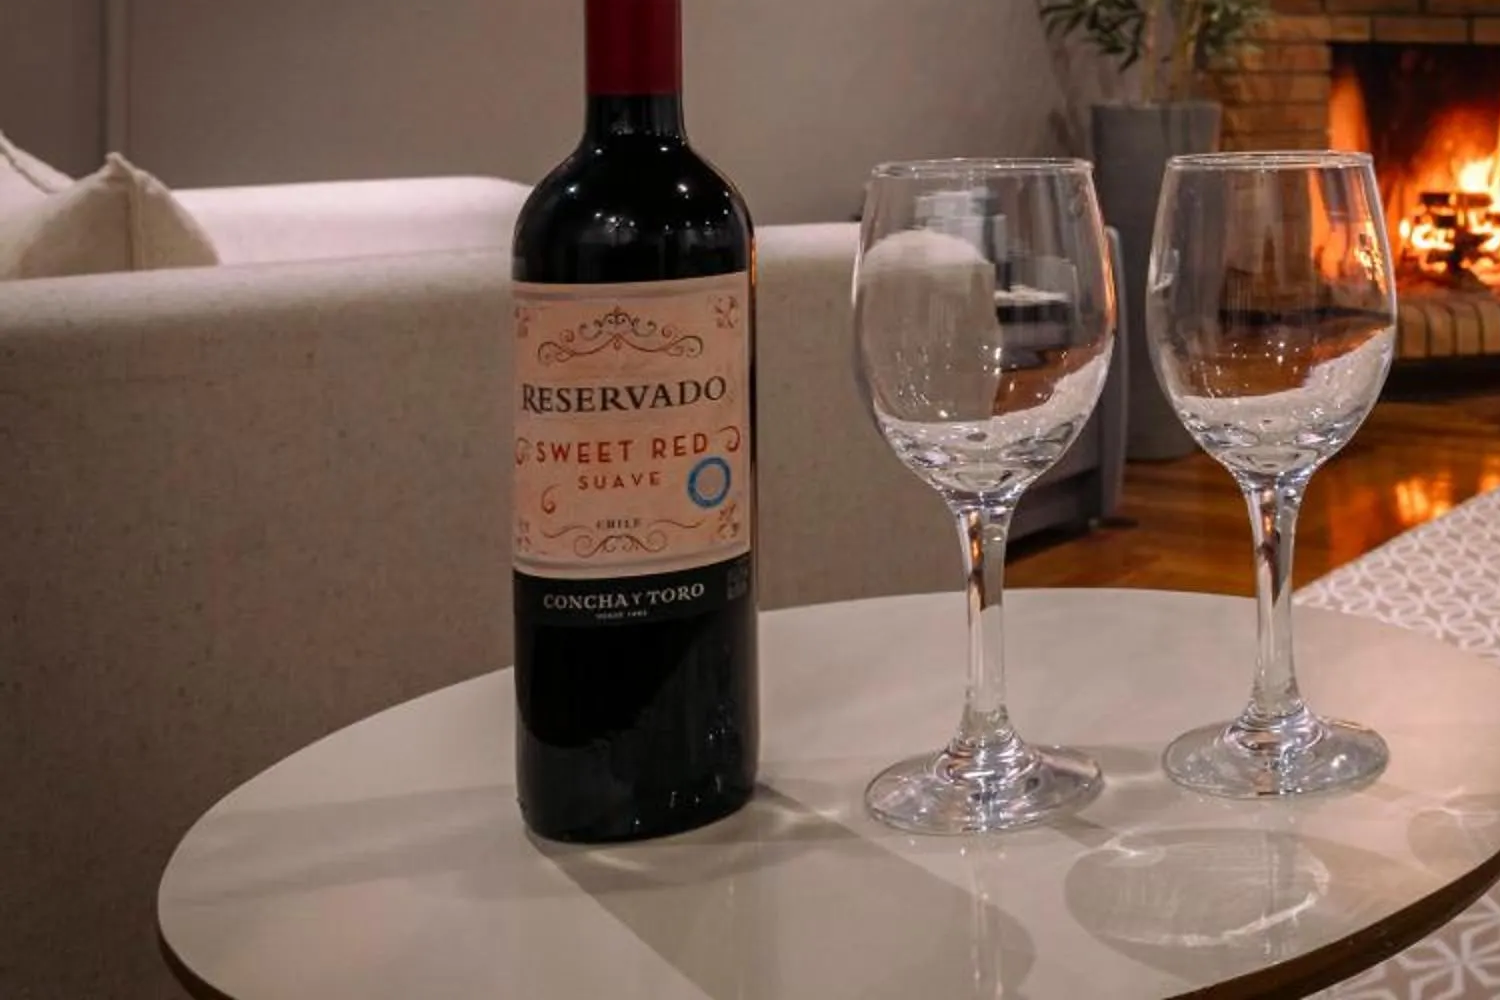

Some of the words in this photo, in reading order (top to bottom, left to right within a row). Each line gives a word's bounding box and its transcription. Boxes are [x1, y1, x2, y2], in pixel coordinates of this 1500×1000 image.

[522, 376, 727, 413] RESERVADO
[536, 440, 634, 464] SWEET
[651, 433, 708, 459] RED
[577, 471, 663, 490] SUAVE
[543, 593, 629, 610] CONCHA
[631, 592, 643, 605] Y
[647, 583, 705, 605] TORO
